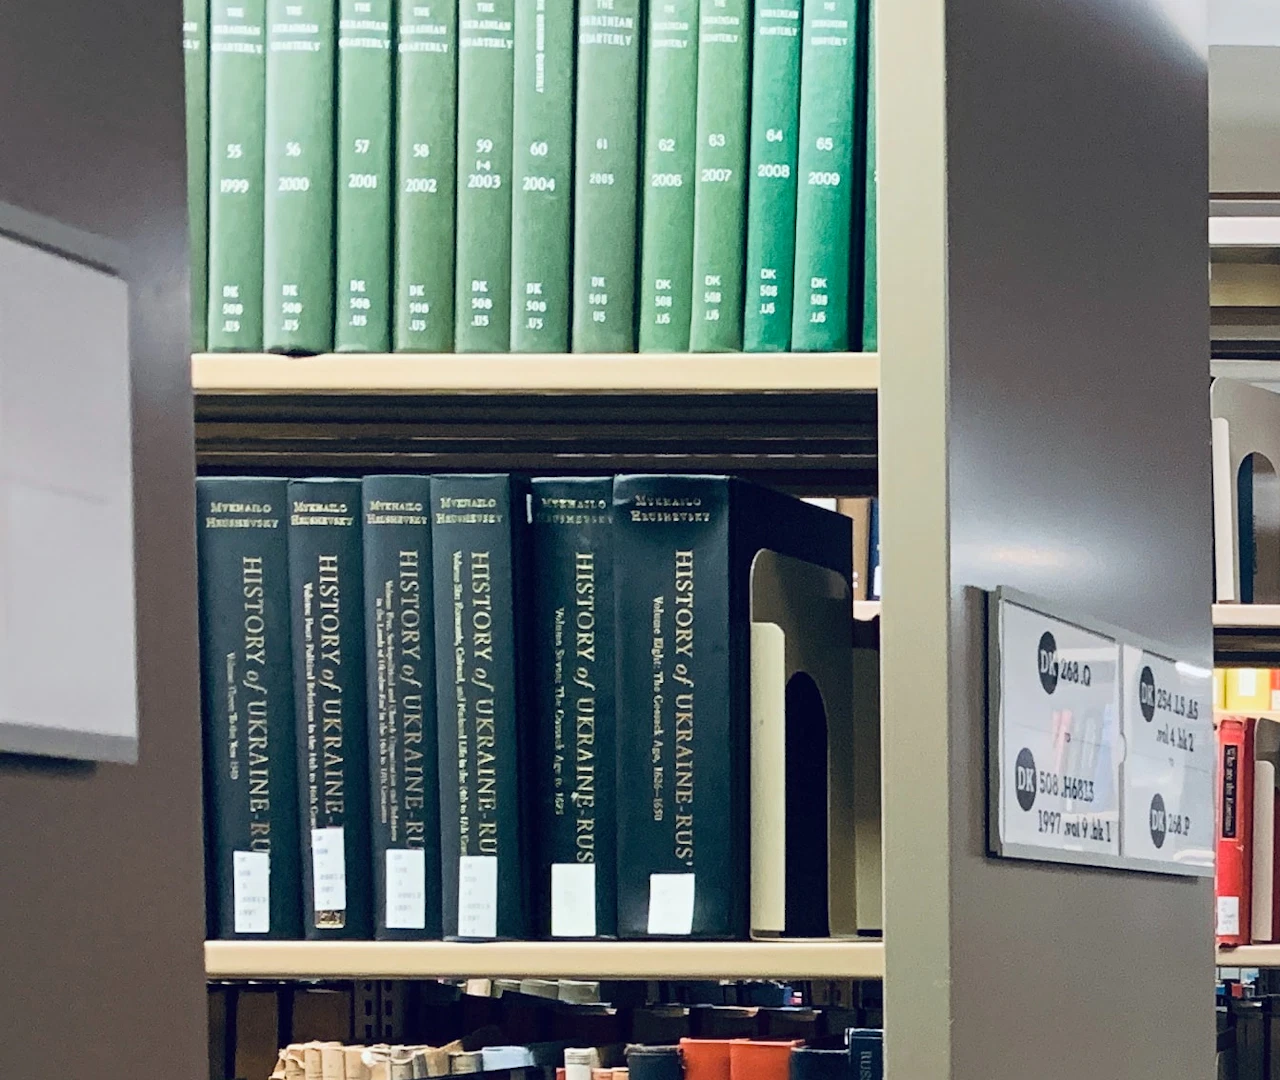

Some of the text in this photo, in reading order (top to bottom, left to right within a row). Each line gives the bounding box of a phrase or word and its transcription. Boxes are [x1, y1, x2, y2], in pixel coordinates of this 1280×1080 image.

[766, 129, 783, 142] 64
[226, 144, 242, 159] 55
[354, 139, 370, 154] 57
[412, 143, 429, 158] 58
[476, 139, 493, 153] 59
[530, 142, 548, 156] 60
[658, 139, 675, 152] 62
[816, 138, 833, 151] 65
[757, 164, 790, 179] 2008
[808, 172, 840, 186] 2009
[220, 179, 249, 193] 1999
[348, 174, 377, 189] 2001
[405, 179, 437, 193] 2002
[467, 174, 501, 189] 2003
[522, 177, 555, 192] 2004
[651, 174, 682, 187] 2006
[655, 279, 671, 290] DK
[675, 550, 695, 659] HISTORY
[399, 550, 422, 689] HISTORY of
[471, 551, 494, 692] HISTORY of
[573, 552, 596, 692] HISTORY of
[653, 595, 664, 635] Volume
[242, 556, 267, 694] HISTORY of
[318, 554, 342, 694] HISTORY of
[653, 671, 664, 692] The
[672, 664, 695, 689] of
[1017, 768, 1035, 793] DK
[1039, 772, 1059, 795] 508
[1038, 809, 1061, 835] 1997
[1081, 820, 1087, 837] 9
